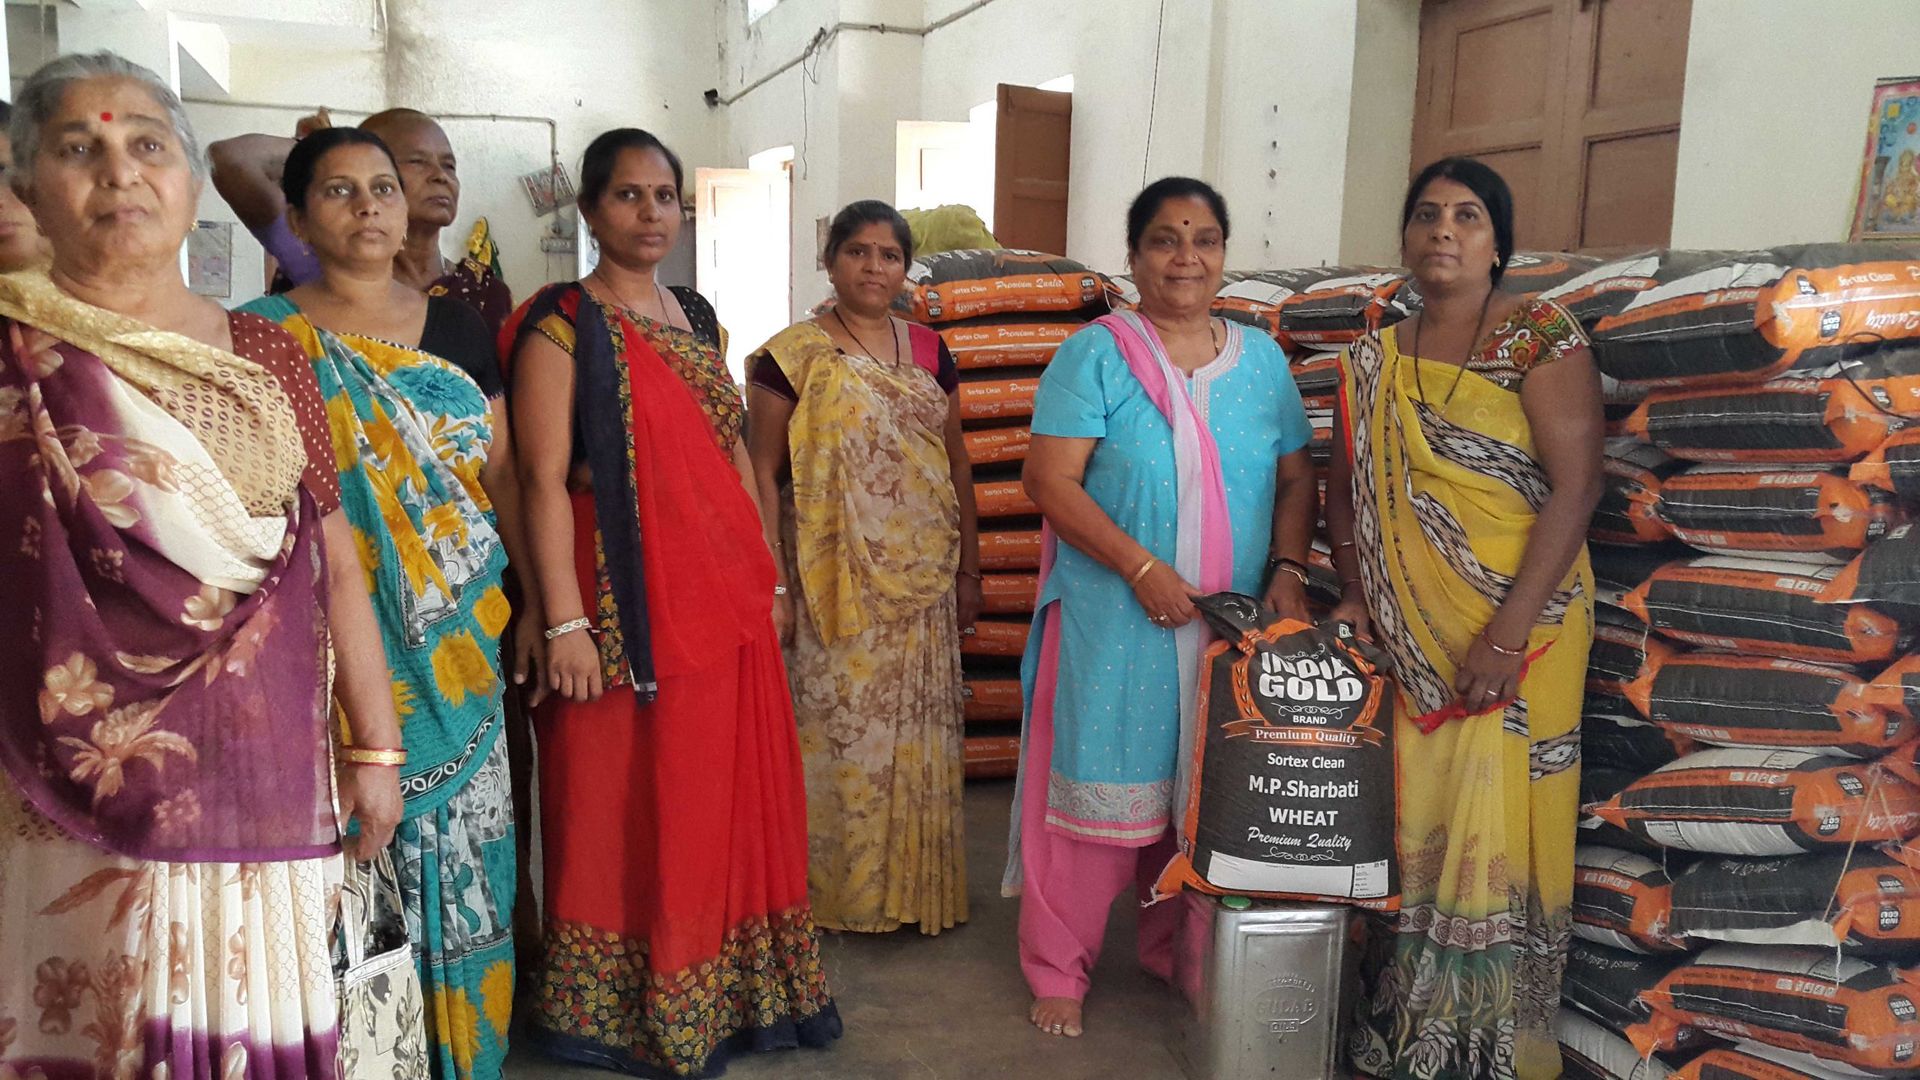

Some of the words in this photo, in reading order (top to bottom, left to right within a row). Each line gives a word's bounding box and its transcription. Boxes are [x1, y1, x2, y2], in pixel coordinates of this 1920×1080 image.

[998, 328, 1034, 338] Premium
[1261, 652, 1356, 680] INDIA
[1259, 673, 1363, 702] GOLD
[1292, 715, 1327, 724] BRAND
[1255, 729, 1312, 740] Premium
[1315, 731, 1357, 745] Quality
[1267, 752, 1309, 768] Sortex
[1312, 756, 1345, 769] Clean
[1248, 774, 1359, 798] M.P.Sharbati
[1268, 806, 1339, 826] WHEAT
[1247, 826, 1302, 847] Premium
[1306, 833, 1352, 852] Quality
